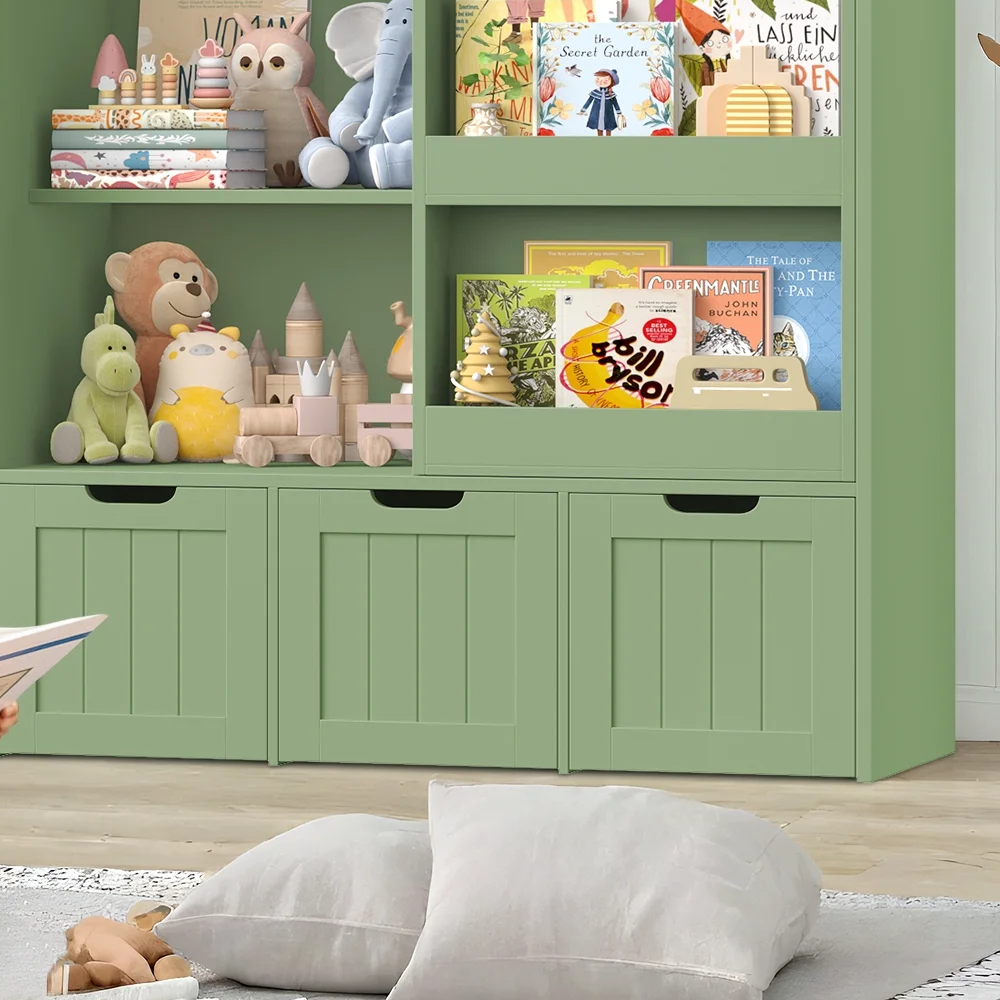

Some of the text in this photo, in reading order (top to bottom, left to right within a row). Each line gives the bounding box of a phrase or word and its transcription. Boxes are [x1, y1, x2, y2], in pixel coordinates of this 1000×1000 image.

[780, 7, 818, 20] und
[594, 34, 612, 43] the
[757, 23, 793, 44] LASS
[560, 44, 648, 58] Secret Garden
[747, 255, 812, 265] THE TALE OF
[778, 269, 835, 281] AND THE
[774, 285, 814, 296] Y-PAN
[725, 300, 758, 308] JOHN
[709, 309, 758, 317] BUCHAN
[531, 356, 556, 369] AP
[613, 336, 664, 377] bill
[573, 363, 590, 388] HISTORY
